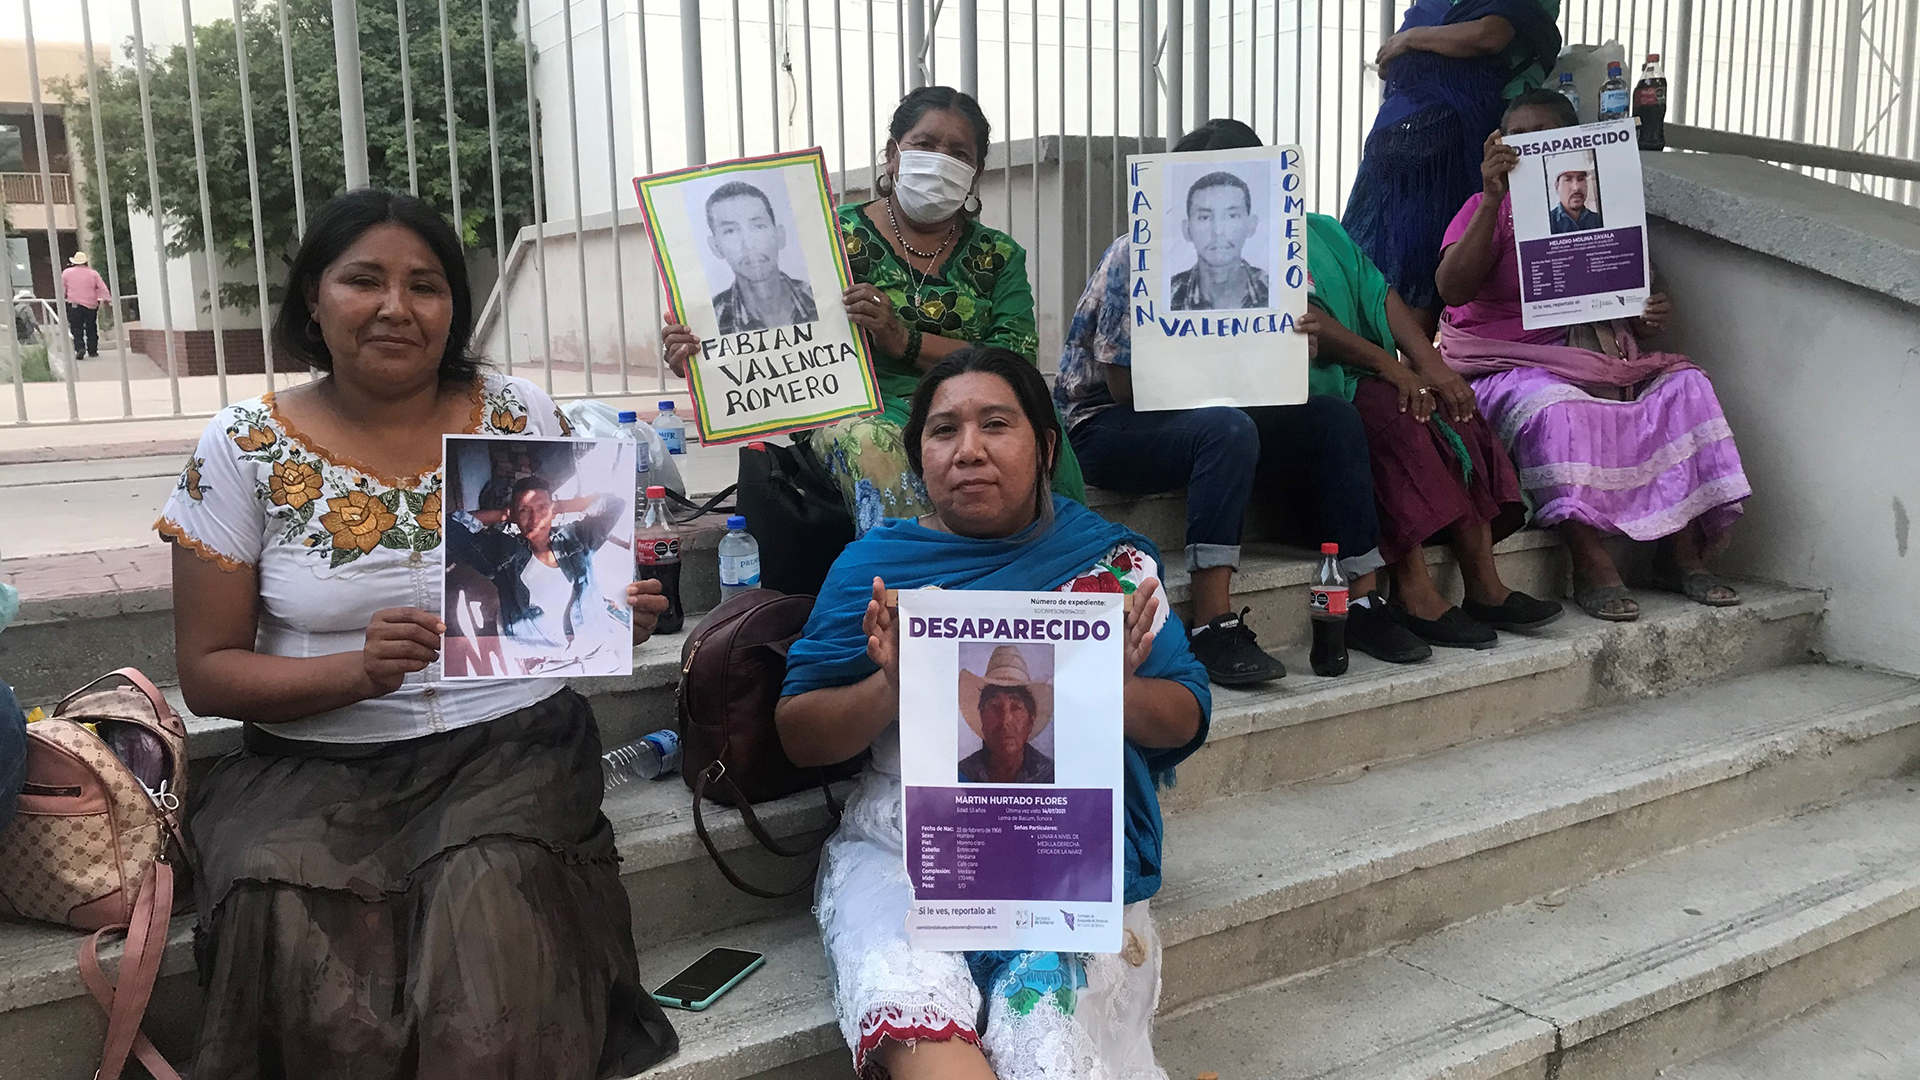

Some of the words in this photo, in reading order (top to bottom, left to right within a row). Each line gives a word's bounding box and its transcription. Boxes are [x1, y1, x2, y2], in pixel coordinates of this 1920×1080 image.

[1280, 149, 1304, 289] ROMERO
[1131, 160, 1155, 327] FABIAN
[1159, 312, 1295, 337] VALENCIA
[700, 323, 813, 362] FABIAN
[718, 342, 858, 387] VALENCIA
[725, 373, 840, 417] ROMERO
[1068, 599, 1107, 607] expediente:
[909, 617, 1111, 641] DESAPARECIDO
[955, 795, 987, 805] MARTIN
[989, 796, 1033, 805] HURTADO
[1034, 796, 1068, 805] FLORES
[918, 906, 926, 915] Si
[927, 906, 934, 915] le
[935, 908, 950, 916] ves,
[951, 907, 986, 916] reportalo
[987, 906, 996, 915] al:
